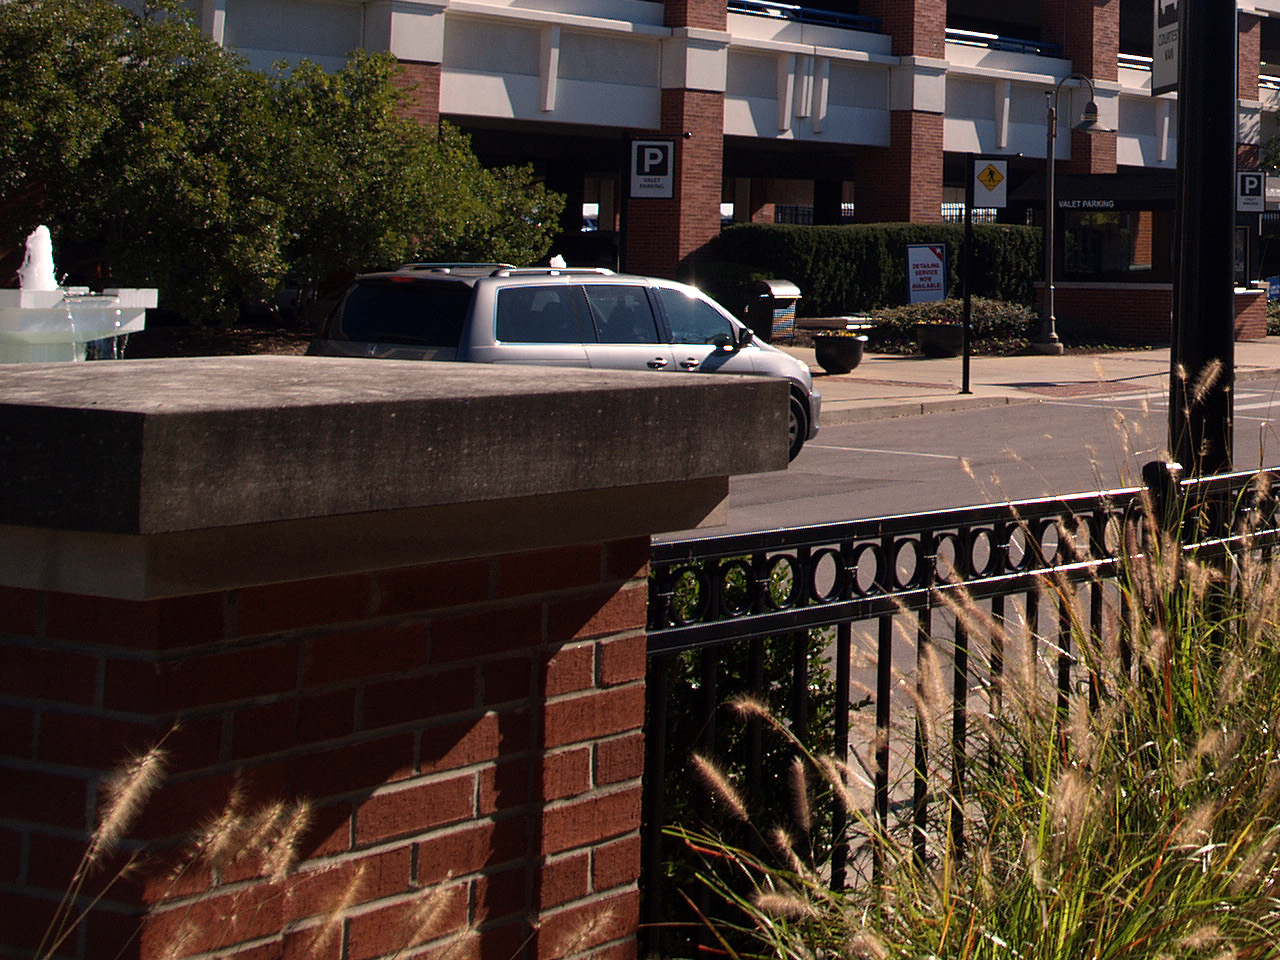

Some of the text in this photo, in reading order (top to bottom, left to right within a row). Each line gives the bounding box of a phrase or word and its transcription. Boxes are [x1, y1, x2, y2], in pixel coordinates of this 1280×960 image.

[644, 147, 664, 173] P
[1244, 176, 1258, 195] P
[1058, 200, 1115, 208] VALET PARKING
